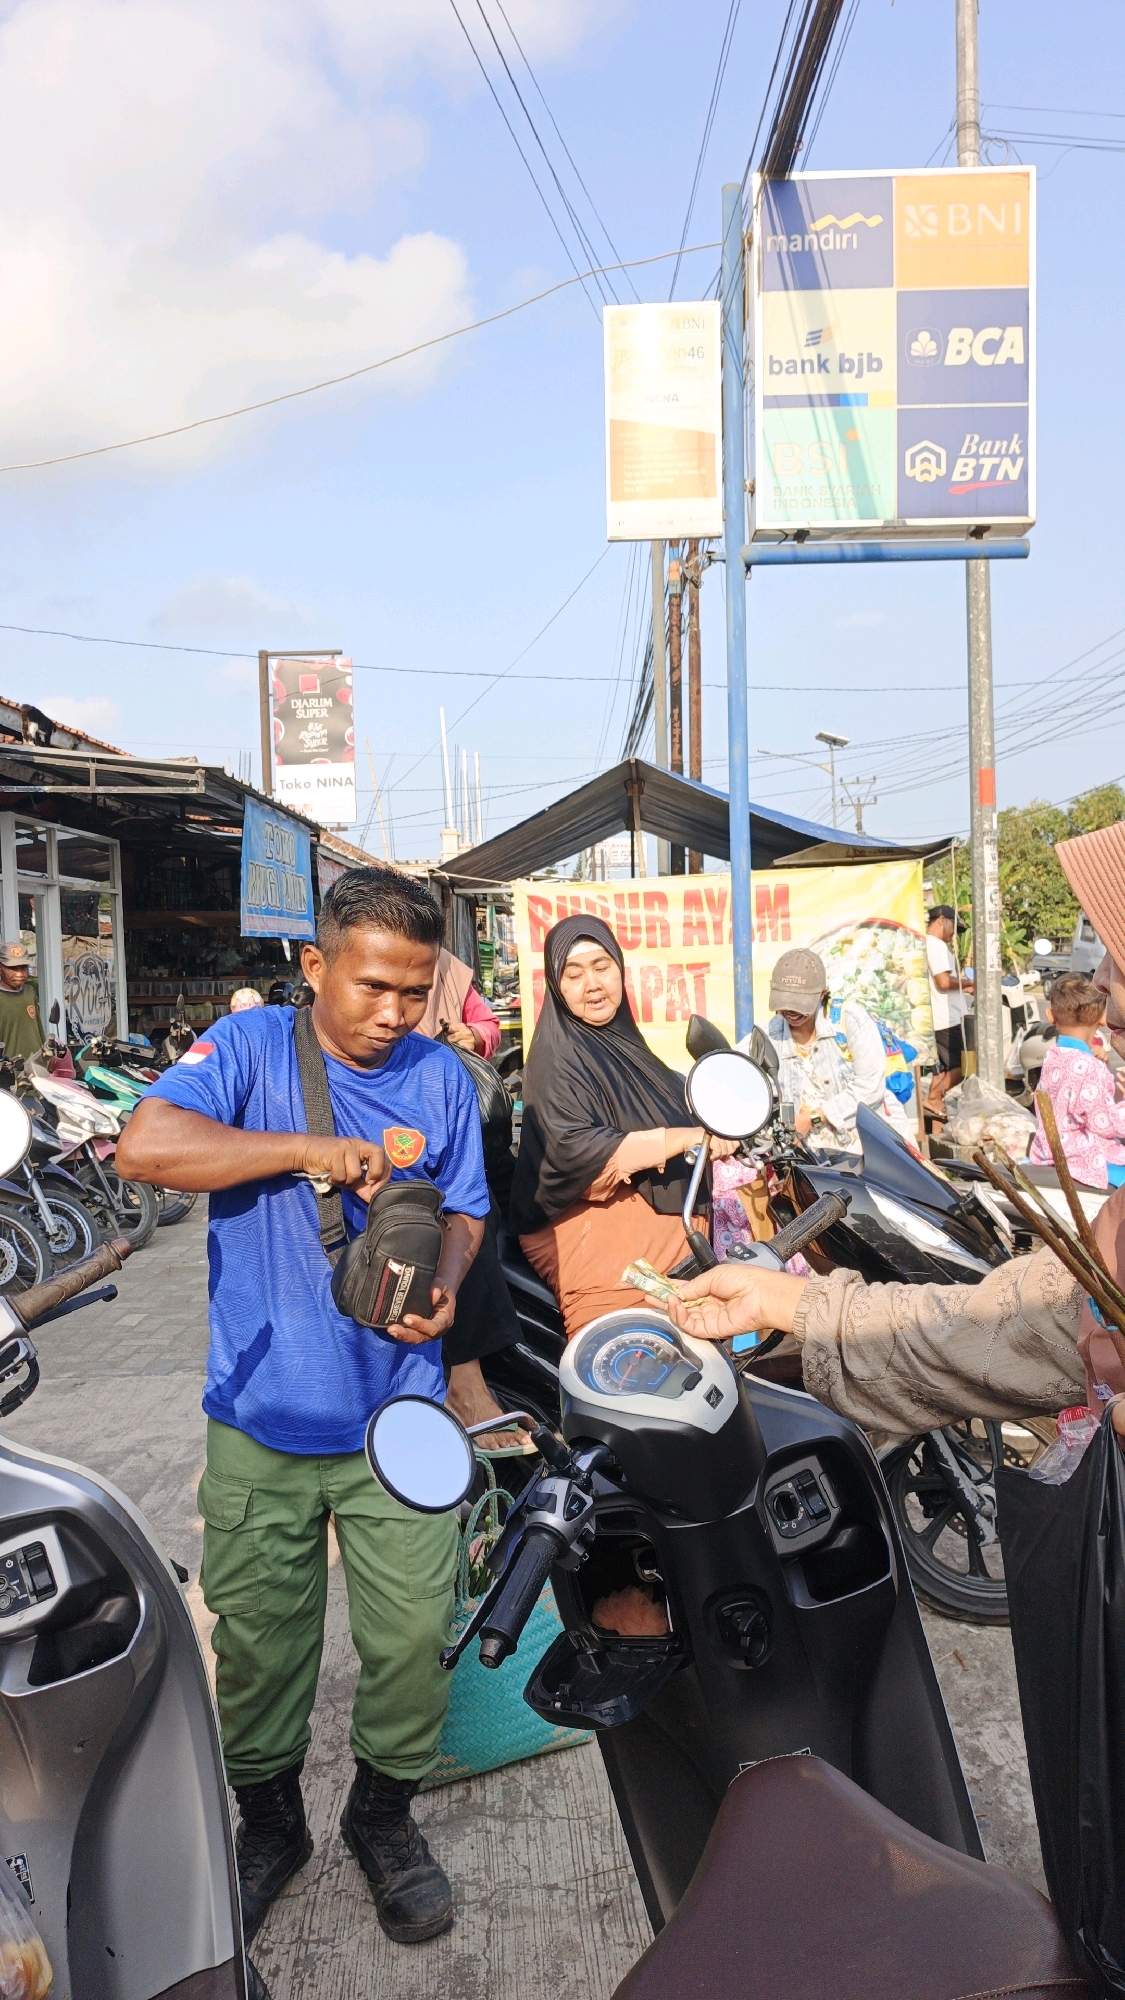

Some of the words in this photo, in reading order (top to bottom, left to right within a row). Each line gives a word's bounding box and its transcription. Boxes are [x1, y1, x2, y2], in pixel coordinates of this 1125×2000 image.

[948, 202, 1022, 236] BNI
[766, 228, 858, 253] mandiri
[943, 326, 1025, 367] BCA
[768, 353, 831, 377] bank
[838, 352, 883, 379] bjb
[959, 432, 1024, 457] Bank
[950, 456, 1025, 482] BTN
[773, 485, 813, 497] BANK
[819, 484, 882, 497] SYARIAH
[773, 498, 858, 510] INDONESIA
[290, 697, 333, 710] DJARUM
[295, 707, 329, 719] SUPER
[279, 779, 312, 790] Toko
[316, 777, 354, 788] NINA
[389, 1291, 405, 1321] FOREVER
[399, 1266, 412, 1292] YOUNG
